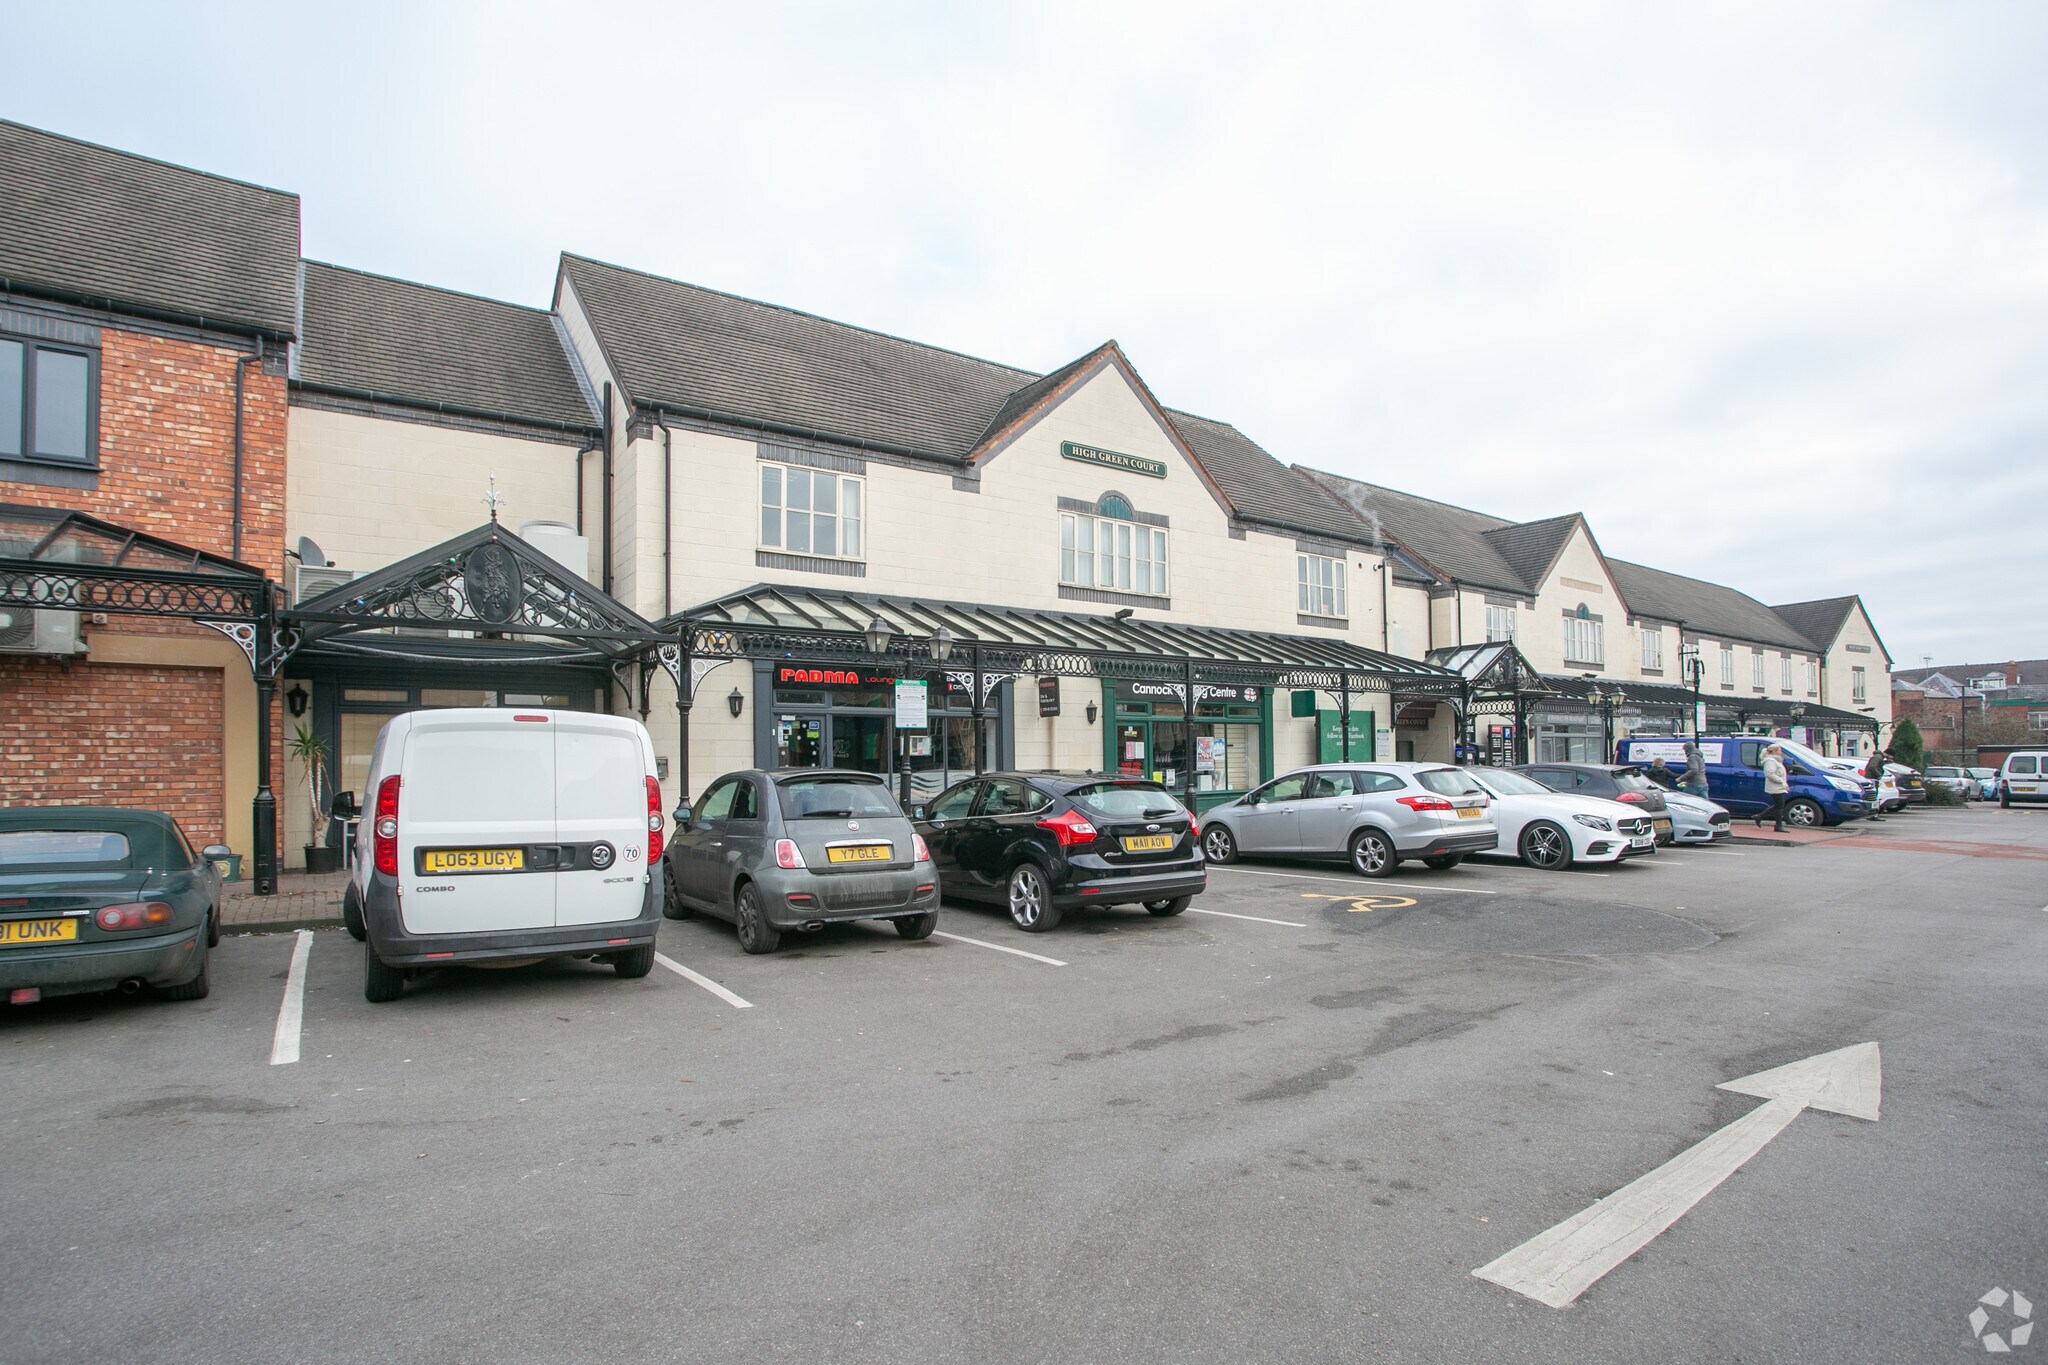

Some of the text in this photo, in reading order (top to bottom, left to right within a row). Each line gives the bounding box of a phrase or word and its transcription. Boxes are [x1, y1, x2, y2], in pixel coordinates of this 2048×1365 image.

[1072, 446, 1159, 473] HIGH GREEN COURT
[780, 668, 895, 685] PADMA Loung
[1132, 682, 1174, 696] Cannock
[1209, 686, 1237, 698] Centre
[435, 850, 516, 868] LO63 UGY
[626, 848, 638, 859] 70
[841, 848, 879, 860] Y7 GLE
[416, 885, 456, 893] COMBO
[19, 921, 63, 939] UNK
